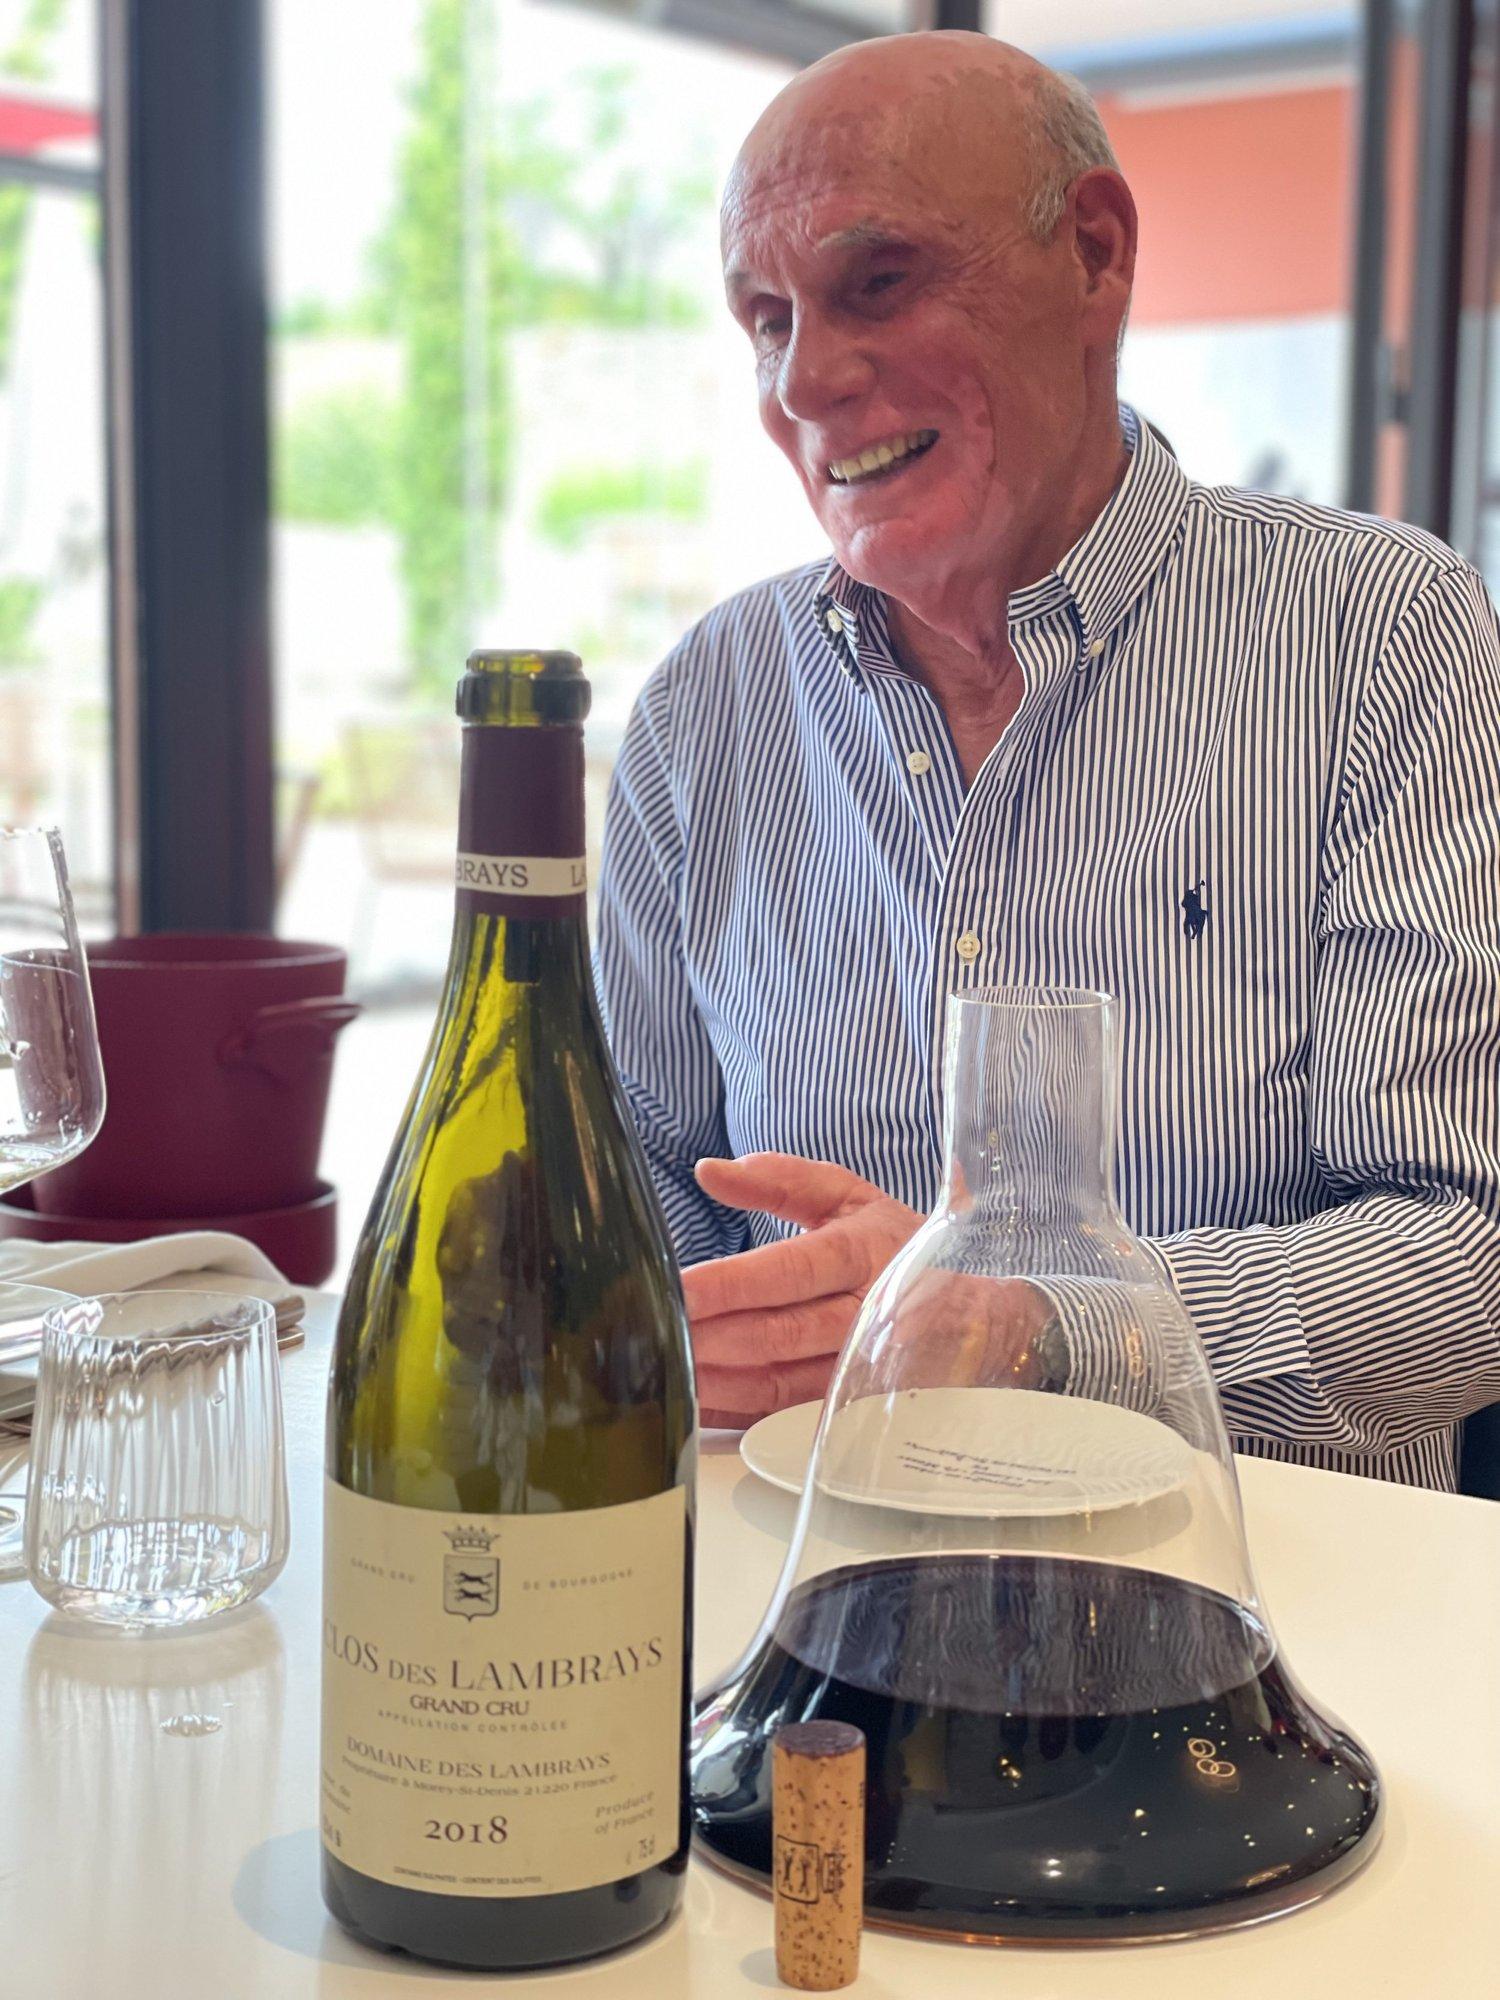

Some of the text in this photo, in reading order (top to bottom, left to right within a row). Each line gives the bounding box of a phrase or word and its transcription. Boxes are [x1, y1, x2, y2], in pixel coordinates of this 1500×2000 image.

[523, 1568, 633, 1591] DE BOURGOGNE
[323, 1617, 662, 1692] CLOS DES LAMBRAYS
[410, 1694, 530, 1716] GRAND CRU
[378, 1709, 469, 1732] APPELLATION
[347, 1736, 611, 1779] DOMAINE DES LAMBRAYS
[523, 1783, 570, 1796] 21220
[573, 1774, 617, 1791] France
[595, 1790, 655, 1818] Produce
[425, 1815, 508, 1844] 2018
[594, 1806, 655, 1835] of France
